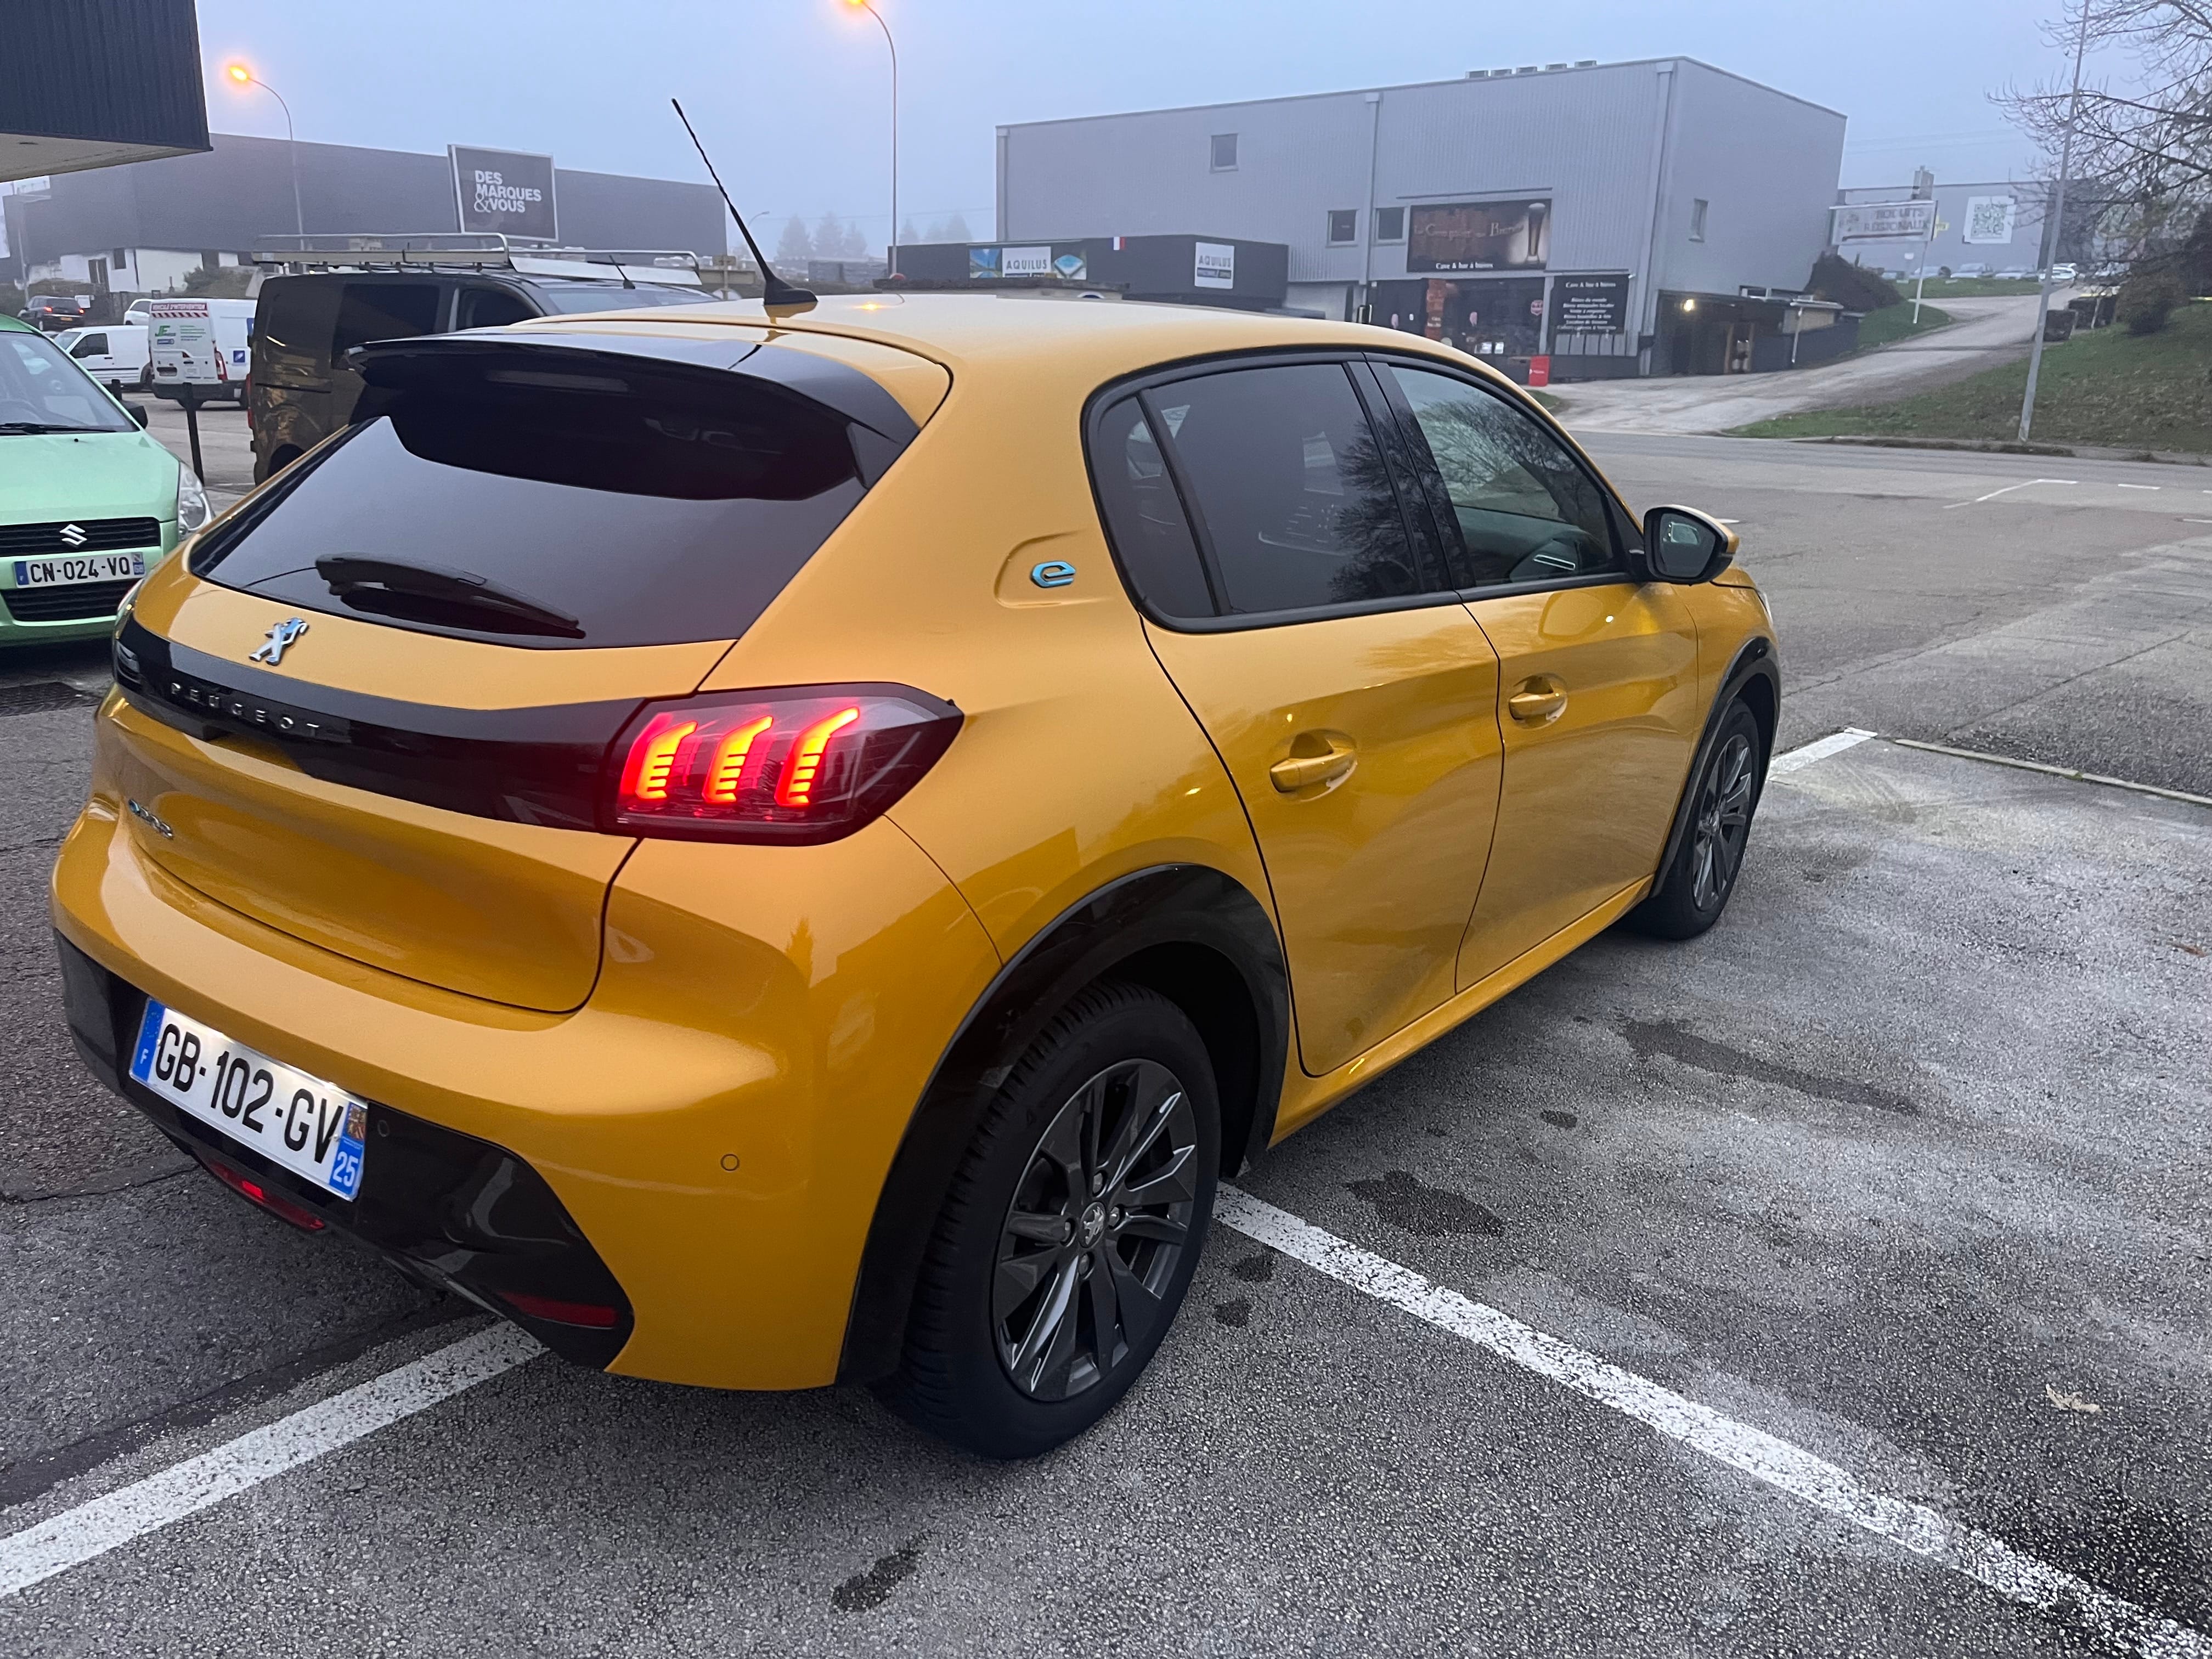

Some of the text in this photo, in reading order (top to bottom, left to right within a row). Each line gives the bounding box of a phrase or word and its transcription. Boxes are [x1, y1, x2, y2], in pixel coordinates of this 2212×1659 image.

[475, 170, 503, 185] DES
[476, 183, 542, 201] MARQUES
[1006, 259, 1047, 269] AQUILUS
[170, 682, 320, 737] PEUGEOT
[139, 1023, 344, 1164] F GB-102-GV
[332, 1151, 359, 1187] 25
